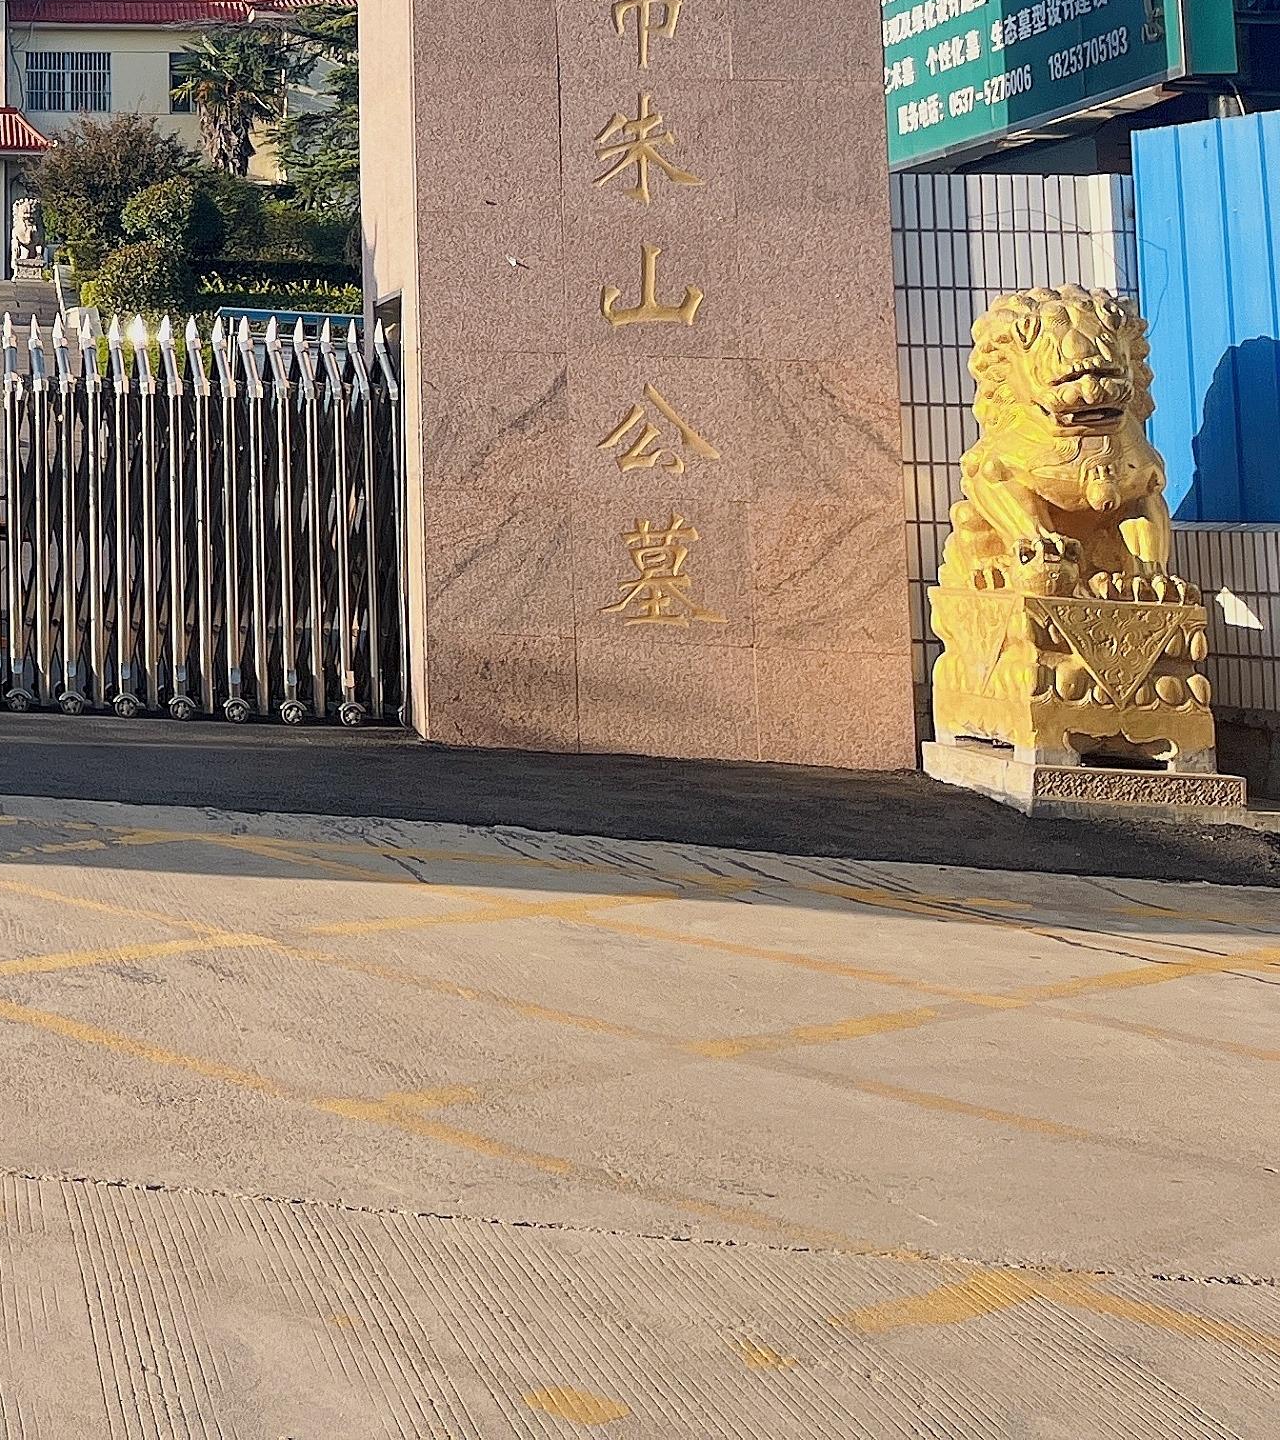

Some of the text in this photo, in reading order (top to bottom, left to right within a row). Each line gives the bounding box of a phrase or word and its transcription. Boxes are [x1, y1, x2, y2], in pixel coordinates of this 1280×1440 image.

[925, 30, 981, 76] 个性化墓
[1048, 26, 1129, 81] 18253705193
